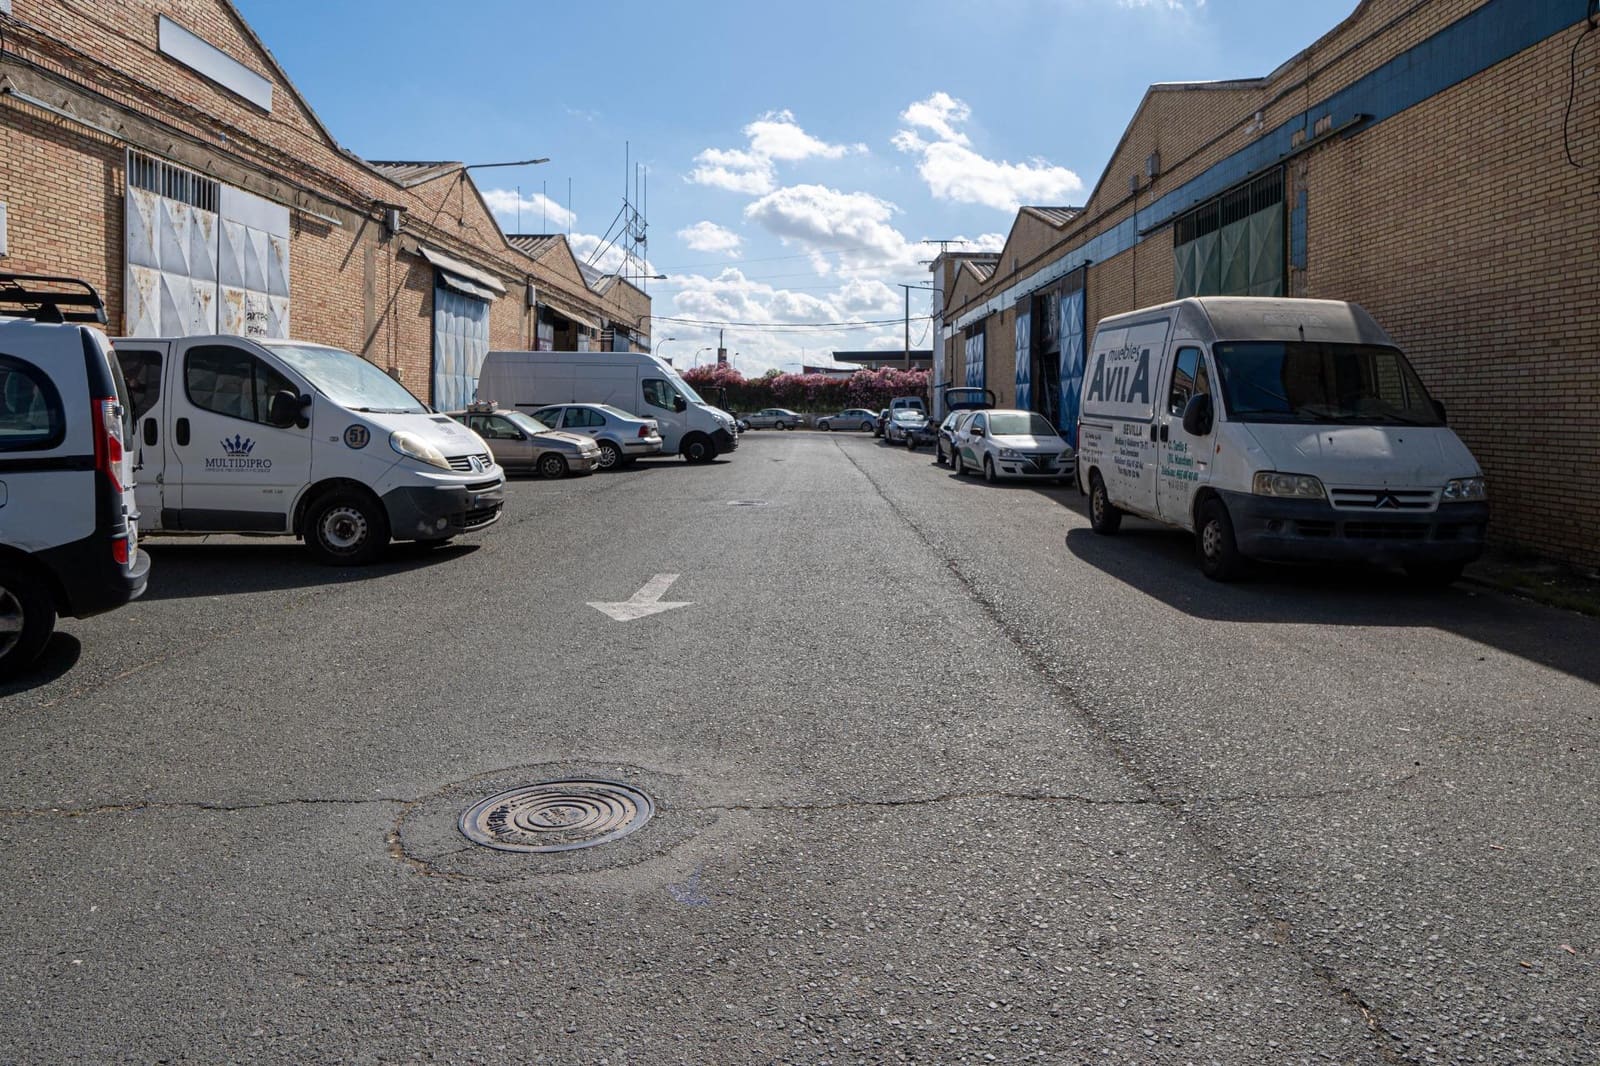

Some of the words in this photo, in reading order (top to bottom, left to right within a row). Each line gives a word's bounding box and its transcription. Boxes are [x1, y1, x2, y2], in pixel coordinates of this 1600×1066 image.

[1108, 343, 1140, 362] muebles
[1087, 349, 1149, 404] AVILA
[350, 429, 365, 443] 51
[1123, 424, 1143, 437] SEVILLA
[205, 458, 272, 468] MULTIDIPRO
